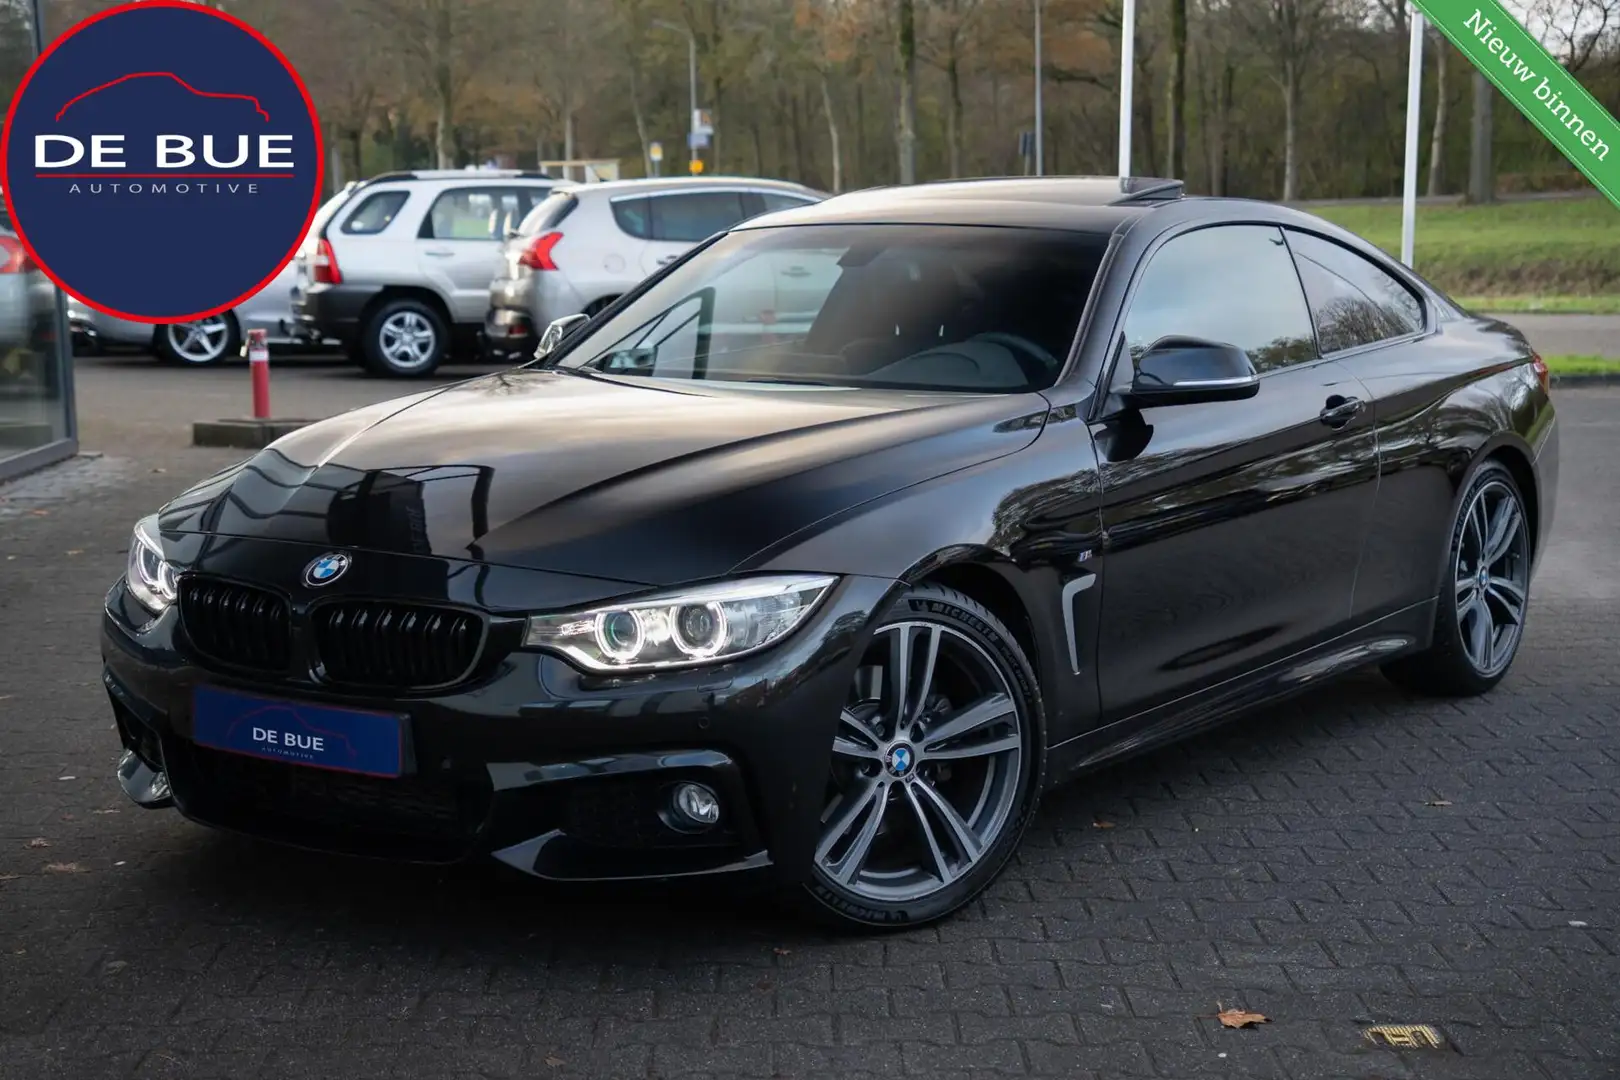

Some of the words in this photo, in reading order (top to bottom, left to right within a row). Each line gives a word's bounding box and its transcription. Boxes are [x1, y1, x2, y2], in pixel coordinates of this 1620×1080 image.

[931, 602, 999, 642] MICHELIN
[252, 727, 278, 744] DE
[284, 732, 325, 752] BUE
